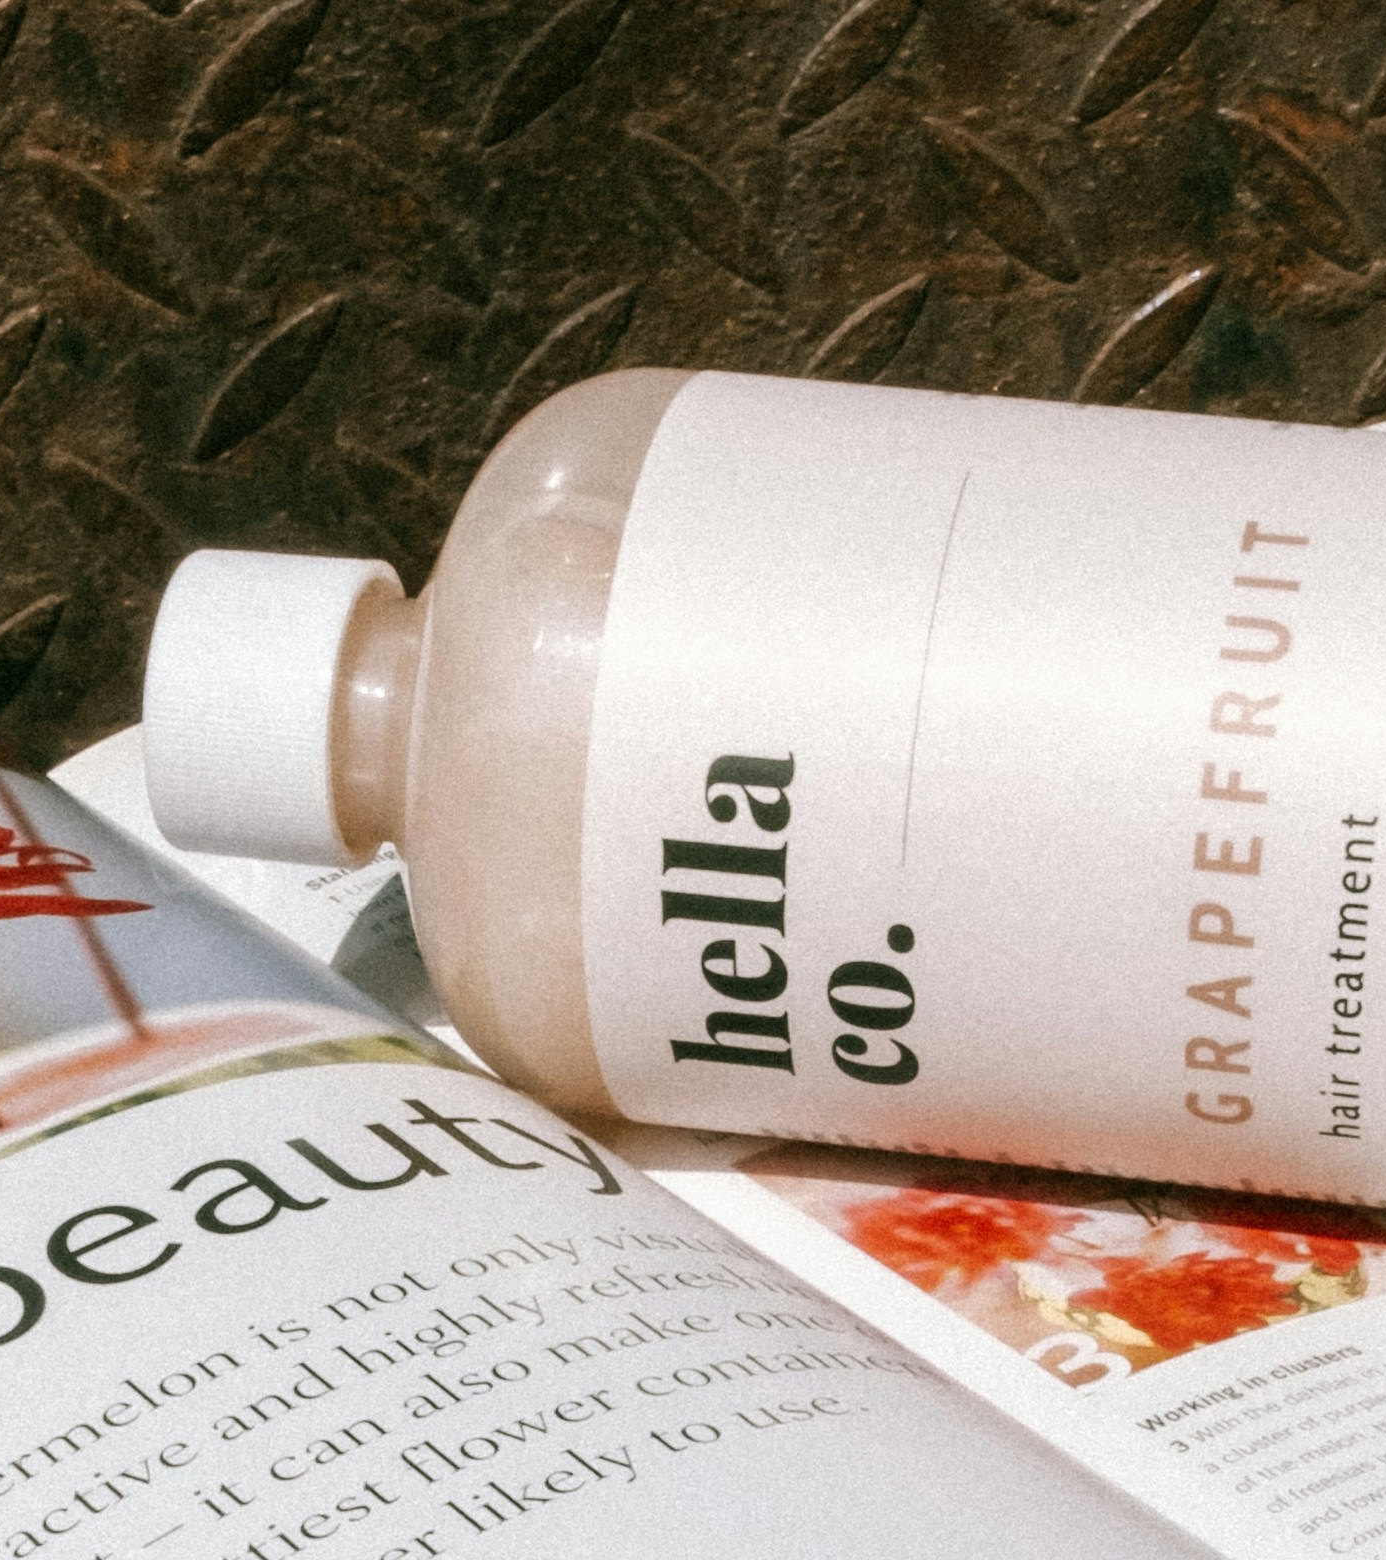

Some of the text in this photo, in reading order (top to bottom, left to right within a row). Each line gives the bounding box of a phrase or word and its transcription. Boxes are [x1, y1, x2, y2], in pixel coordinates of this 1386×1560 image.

[1186, 519, 1311, 1126] GRAPEFRUIT
[661, 750, 796, 1075] hella
[1319, 815, 1378, 1139] hair treatment
[827, 924, 920, 1086] co.
[219, 1360, 337, 1442] and
[334, 1293, 545, 1376] highly
[254, 1322, 312, 1352] is
[323, 1270, 433, 1322] not
[447, 1231, 580, 1278] only
[201, 1482, 251, 1519] it
[267, 1417, 389, 1483] can
[410, 1359, 532, 1420] also
[543, 1310, 718, 1366] make
[733, 1309, 851, 1335] one
[398, 1388, 614, 1485] flower
[444, 1445, 638, 1534] likely
[648, 1422, 722, 1454] to
[735, 1393, 871, 1430] use.
[1135, 1344, 1364, 1433] Working in clusters
